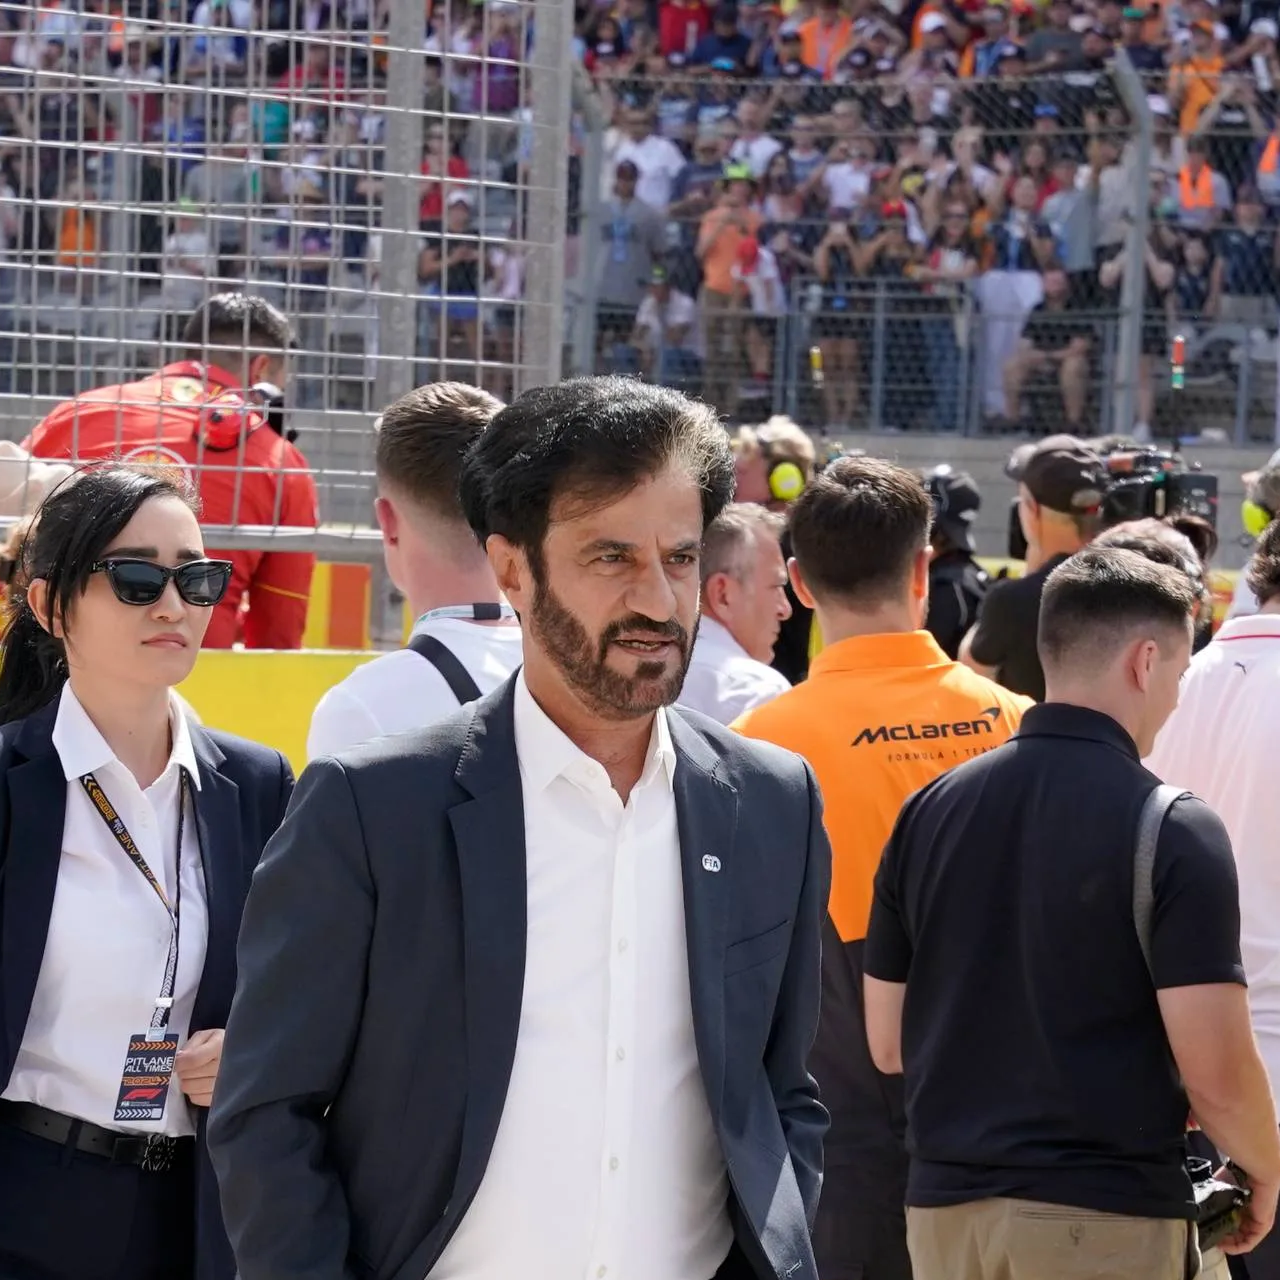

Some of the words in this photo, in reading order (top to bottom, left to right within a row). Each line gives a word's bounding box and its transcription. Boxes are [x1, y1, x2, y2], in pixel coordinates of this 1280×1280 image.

[851, 719, 992, 747] McLaren
[887, 752, 945, 763] FORMULA
[703, 858, 719, 870] FIA
[125, 1056, 174, 1066] PITLANE
[124, 1064, 141, 1073] ALL
[145, 1063, 172, 1073] TIMES
